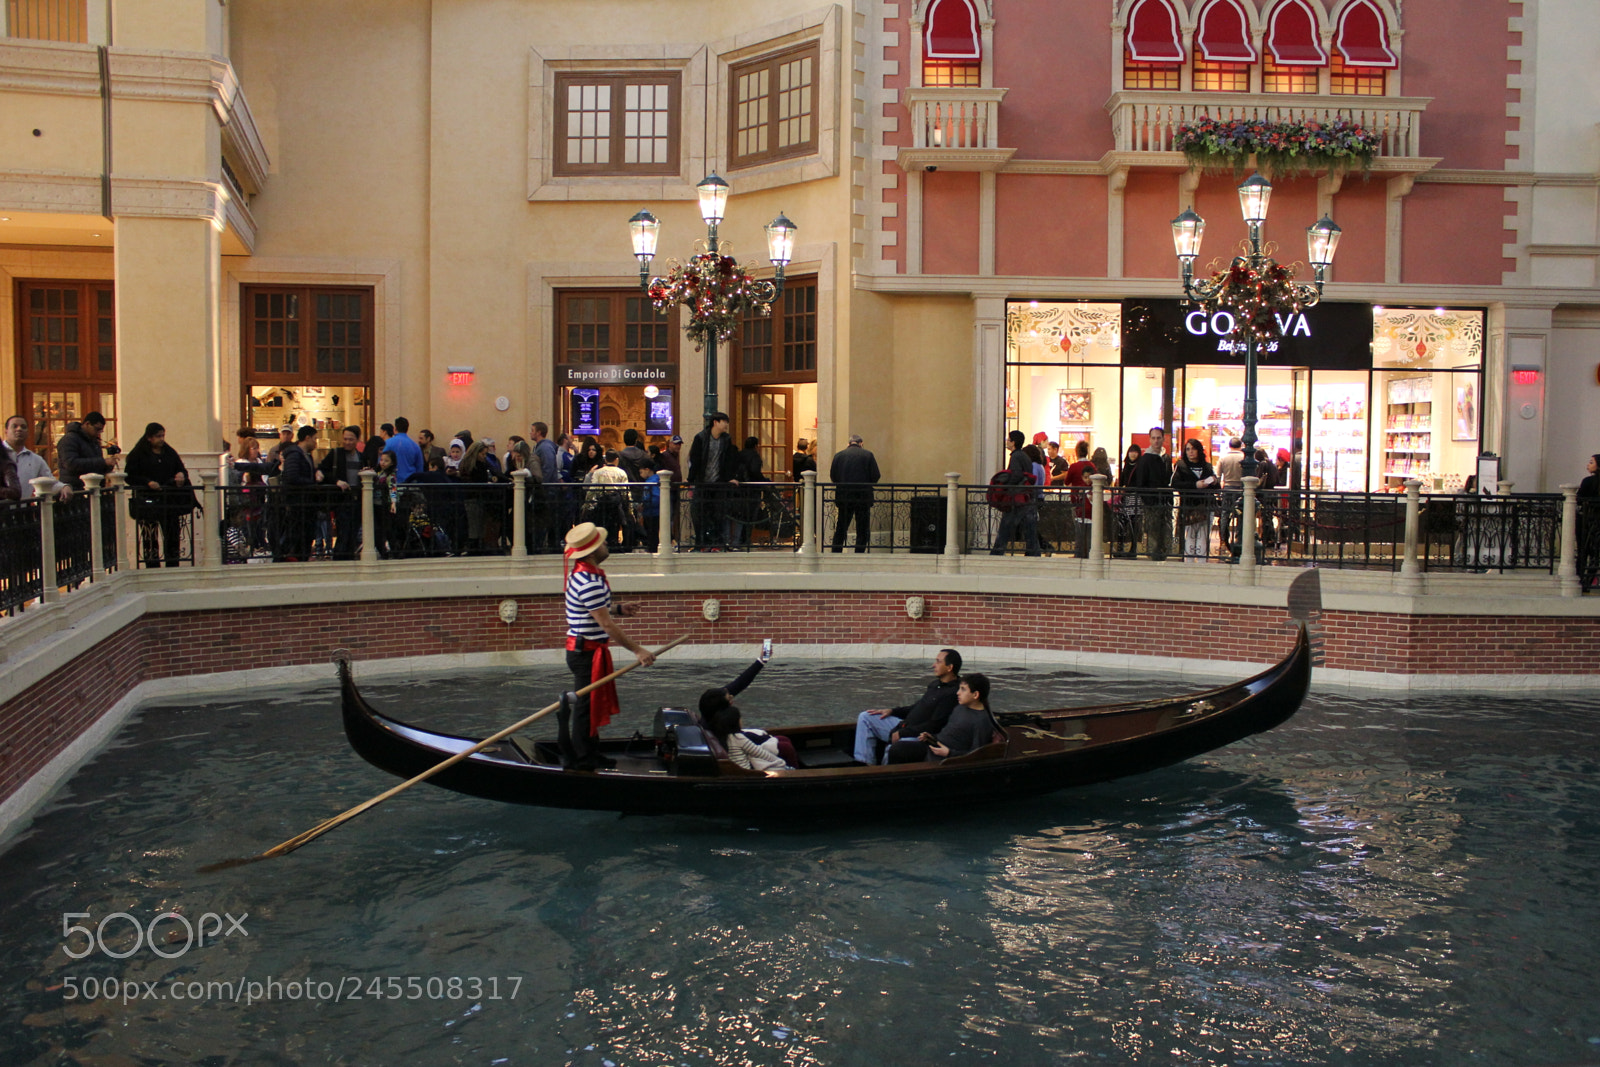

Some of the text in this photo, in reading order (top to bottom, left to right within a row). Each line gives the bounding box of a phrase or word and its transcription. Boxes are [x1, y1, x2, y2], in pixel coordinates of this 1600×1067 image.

[1185, 311, 1312, 337] GOVA
[453, 373, 469, 385] EXIT
[567, 368, 666, 381] Emporio Di Gondola
[1519, 371, 1536, 384] EXIT
